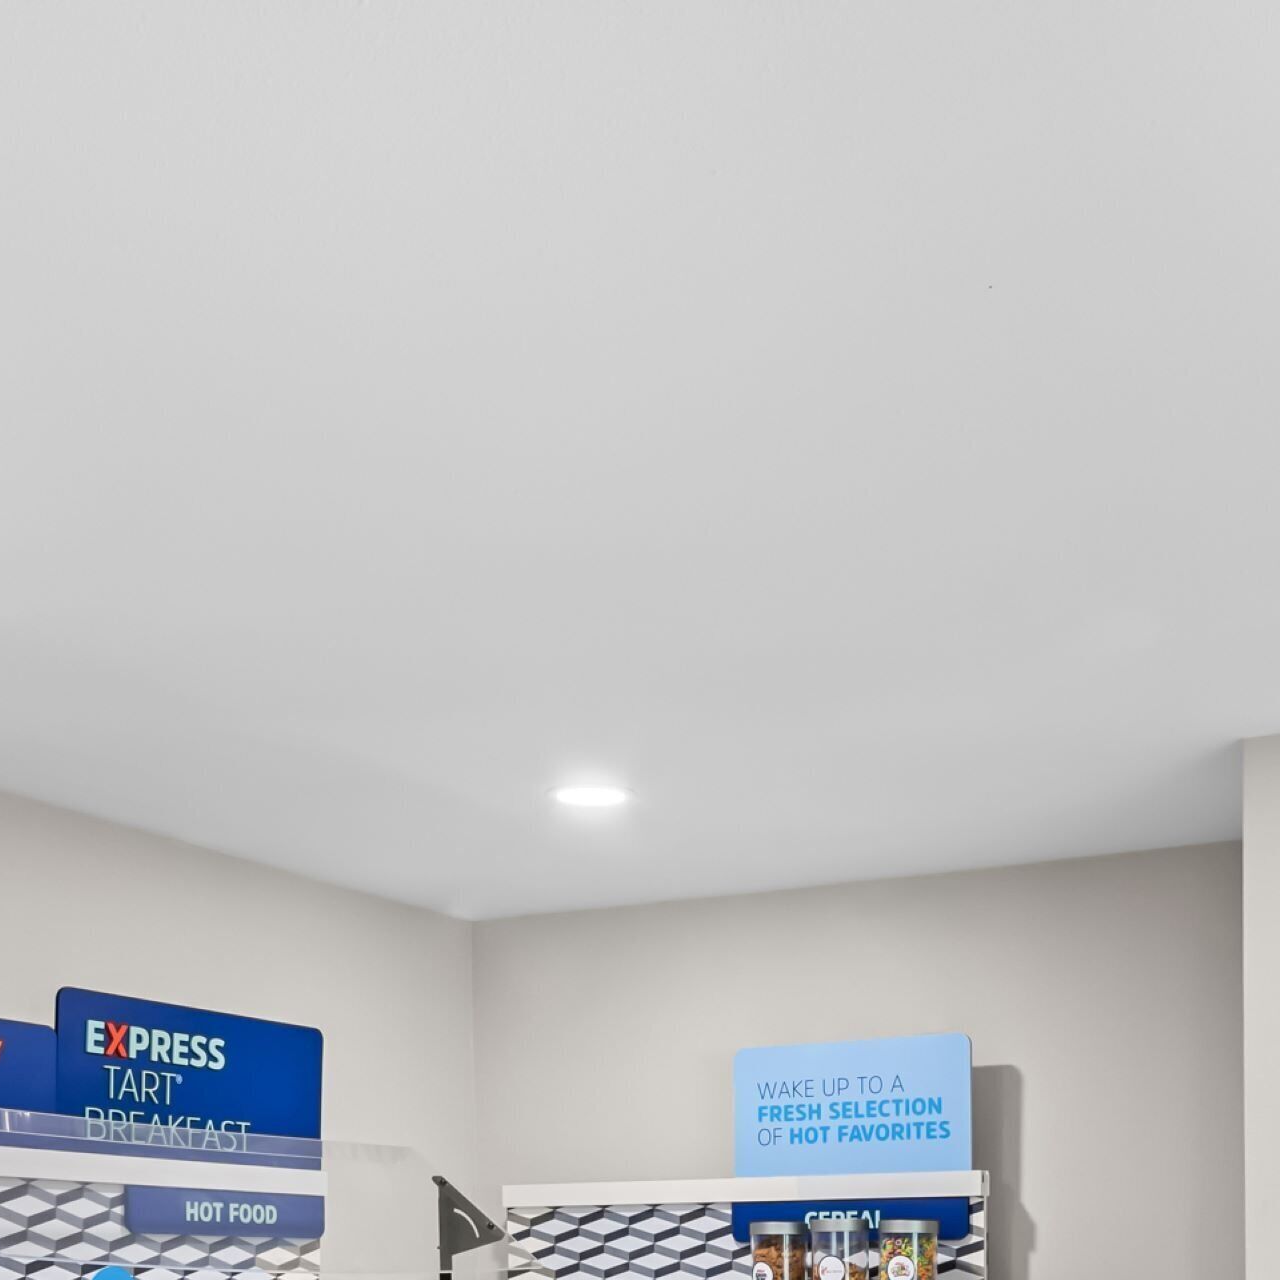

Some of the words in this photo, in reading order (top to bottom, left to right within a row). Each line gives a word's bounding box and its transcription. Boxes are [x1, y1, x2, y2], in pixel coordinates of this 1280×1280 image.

[86, 1019, 226, 1070] EXPRESS
[757, 1079, 815, 1100] WAKE
[822, 1077, 850, 1097] UP
[856, 1075, 883, 1095] TO
[890, 1074, 905, 1093] A
[757, 1103, 822, 1122] FRESH
[828, 1096, 942, 1120] SELECTION
[84, 1106, 251, 1153] BREAKFAST
[757, 1127, 783, 1147] OF
[789, 1125, 830, 1145] HOT
[837, 1120, 951, 1143] FAVORITES
[185, 1200, 224, 1223] HOT
[229, 1203, 278, 1225] FOOD
